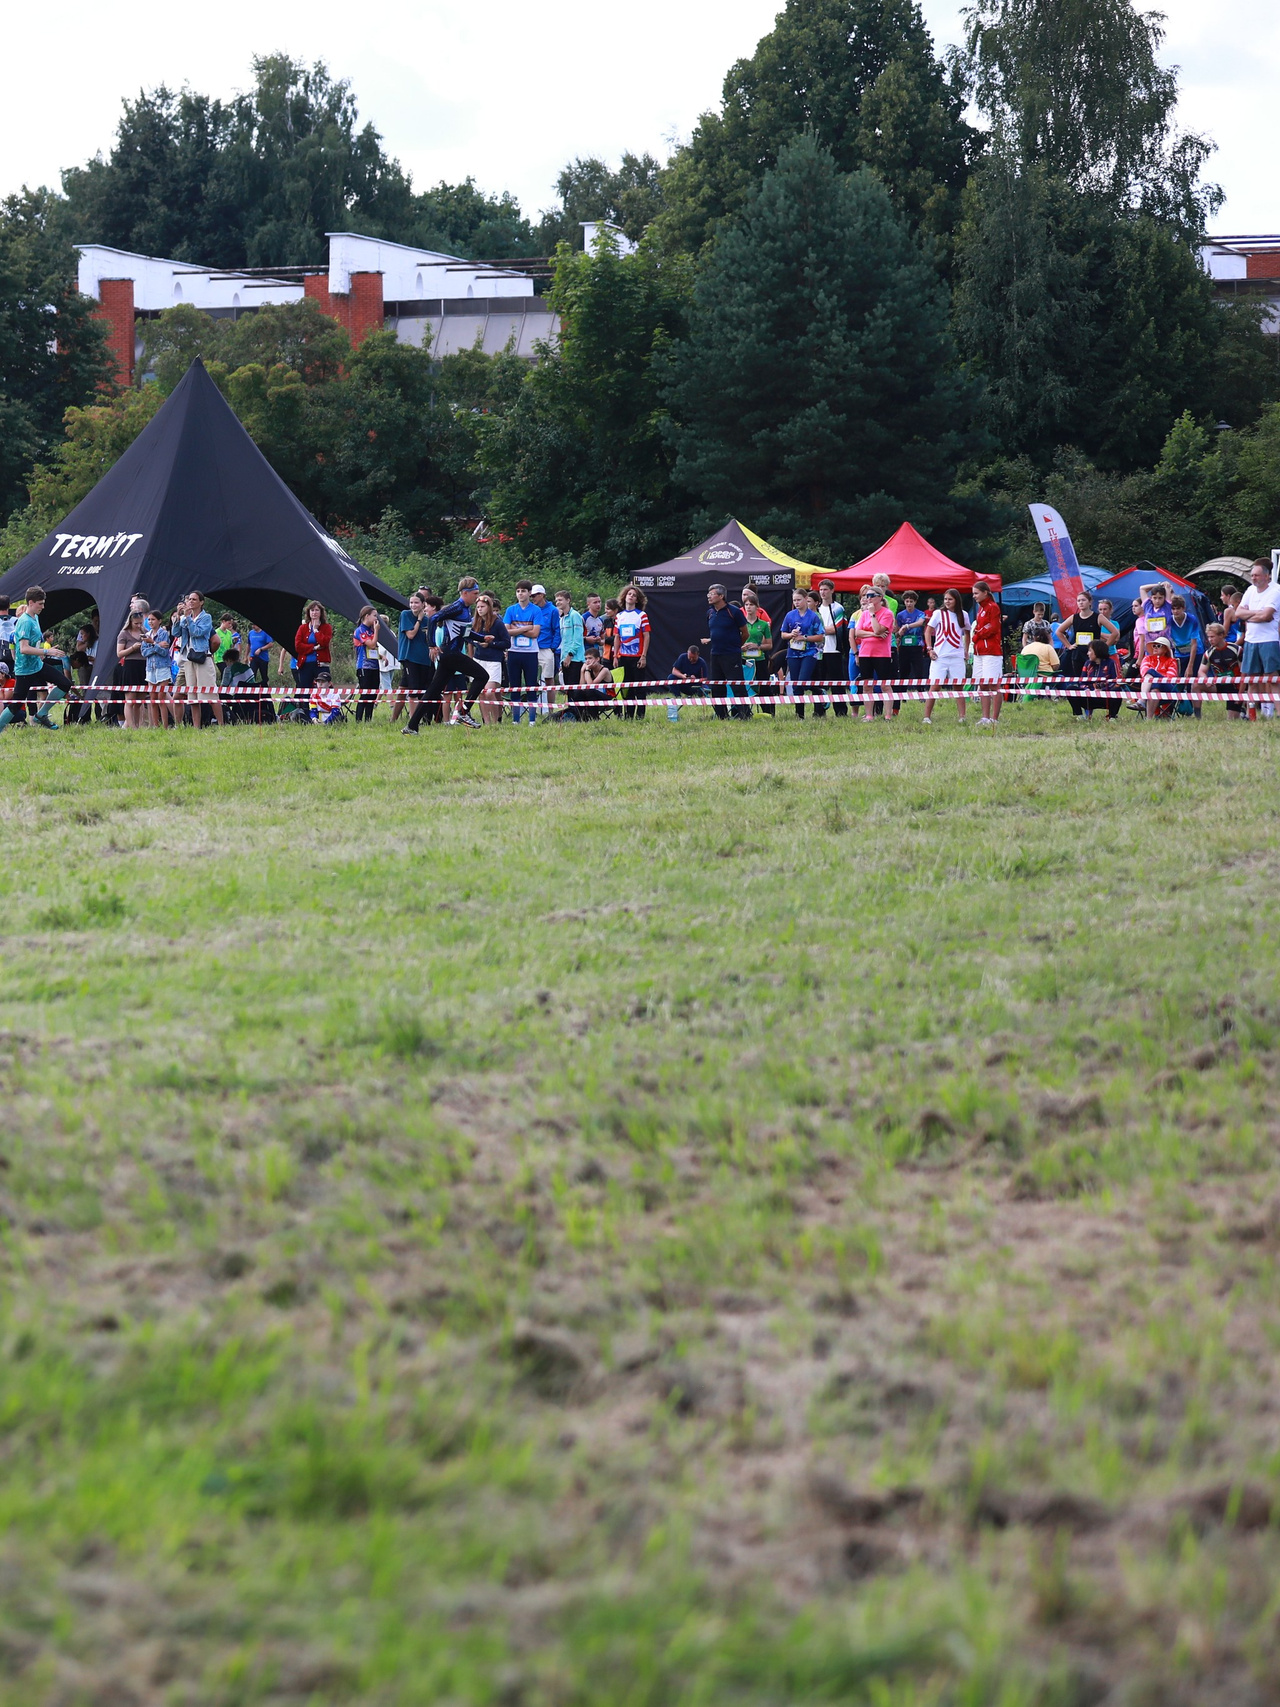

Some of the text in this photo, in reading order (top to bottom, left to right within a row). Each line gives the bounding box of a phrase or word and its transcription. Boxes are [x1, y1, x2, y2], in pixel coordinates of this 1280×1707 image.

[49, 532, 144, 559] TERMIT
[58, 565, 75, 575] IT'S
[72, 566, 87, 575] ALL
